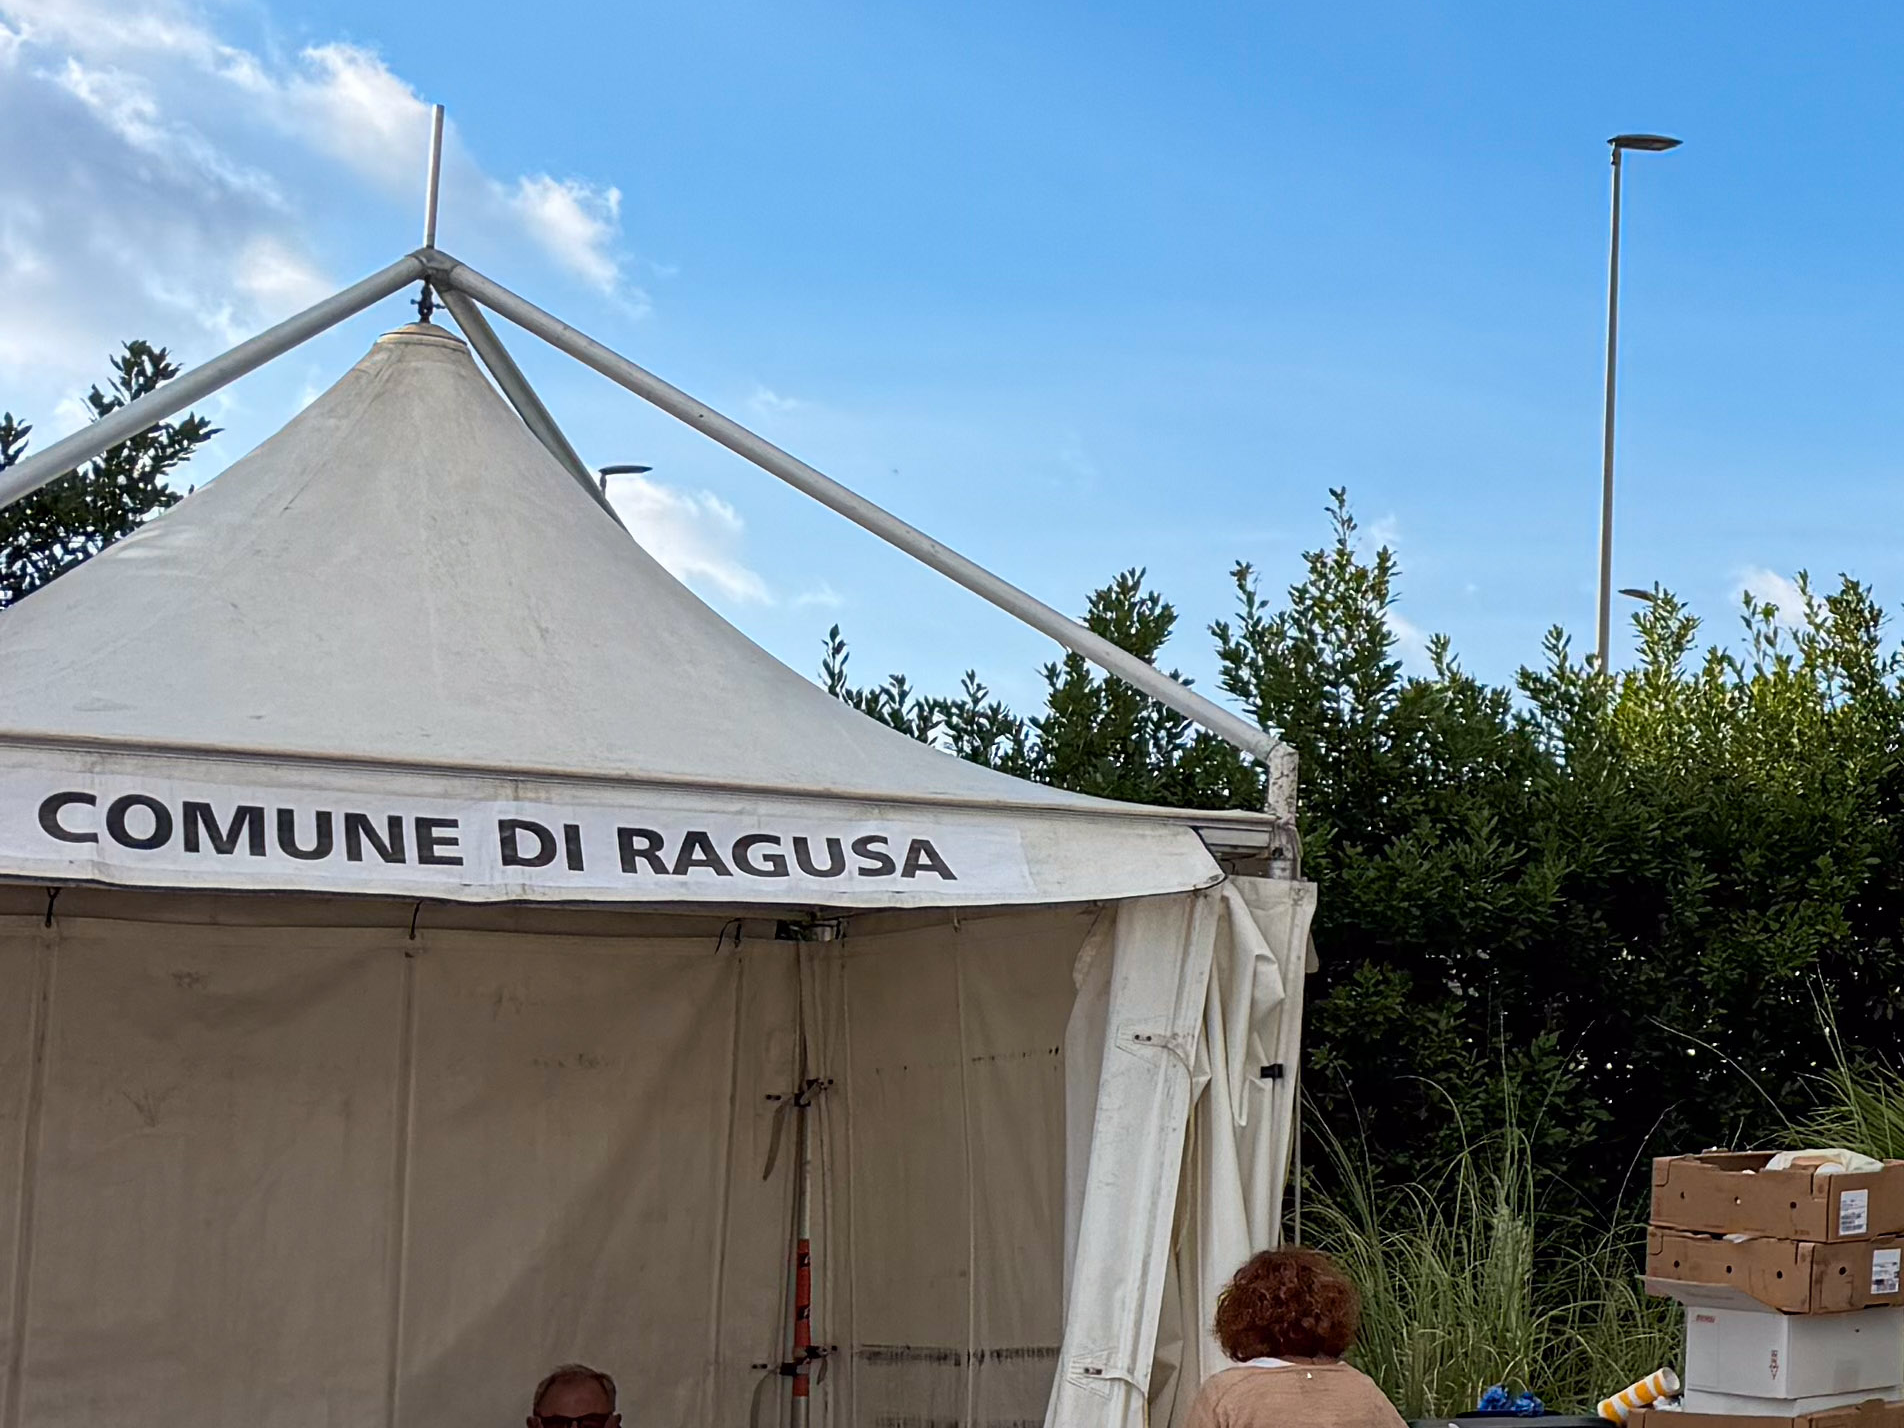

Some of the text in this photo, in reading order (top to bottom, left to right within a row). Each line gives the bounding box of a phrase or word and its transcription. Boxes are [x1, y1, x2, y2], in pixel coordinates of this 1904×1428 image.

[37, 790, 959, 881] COMUNE DI RAGUSA
